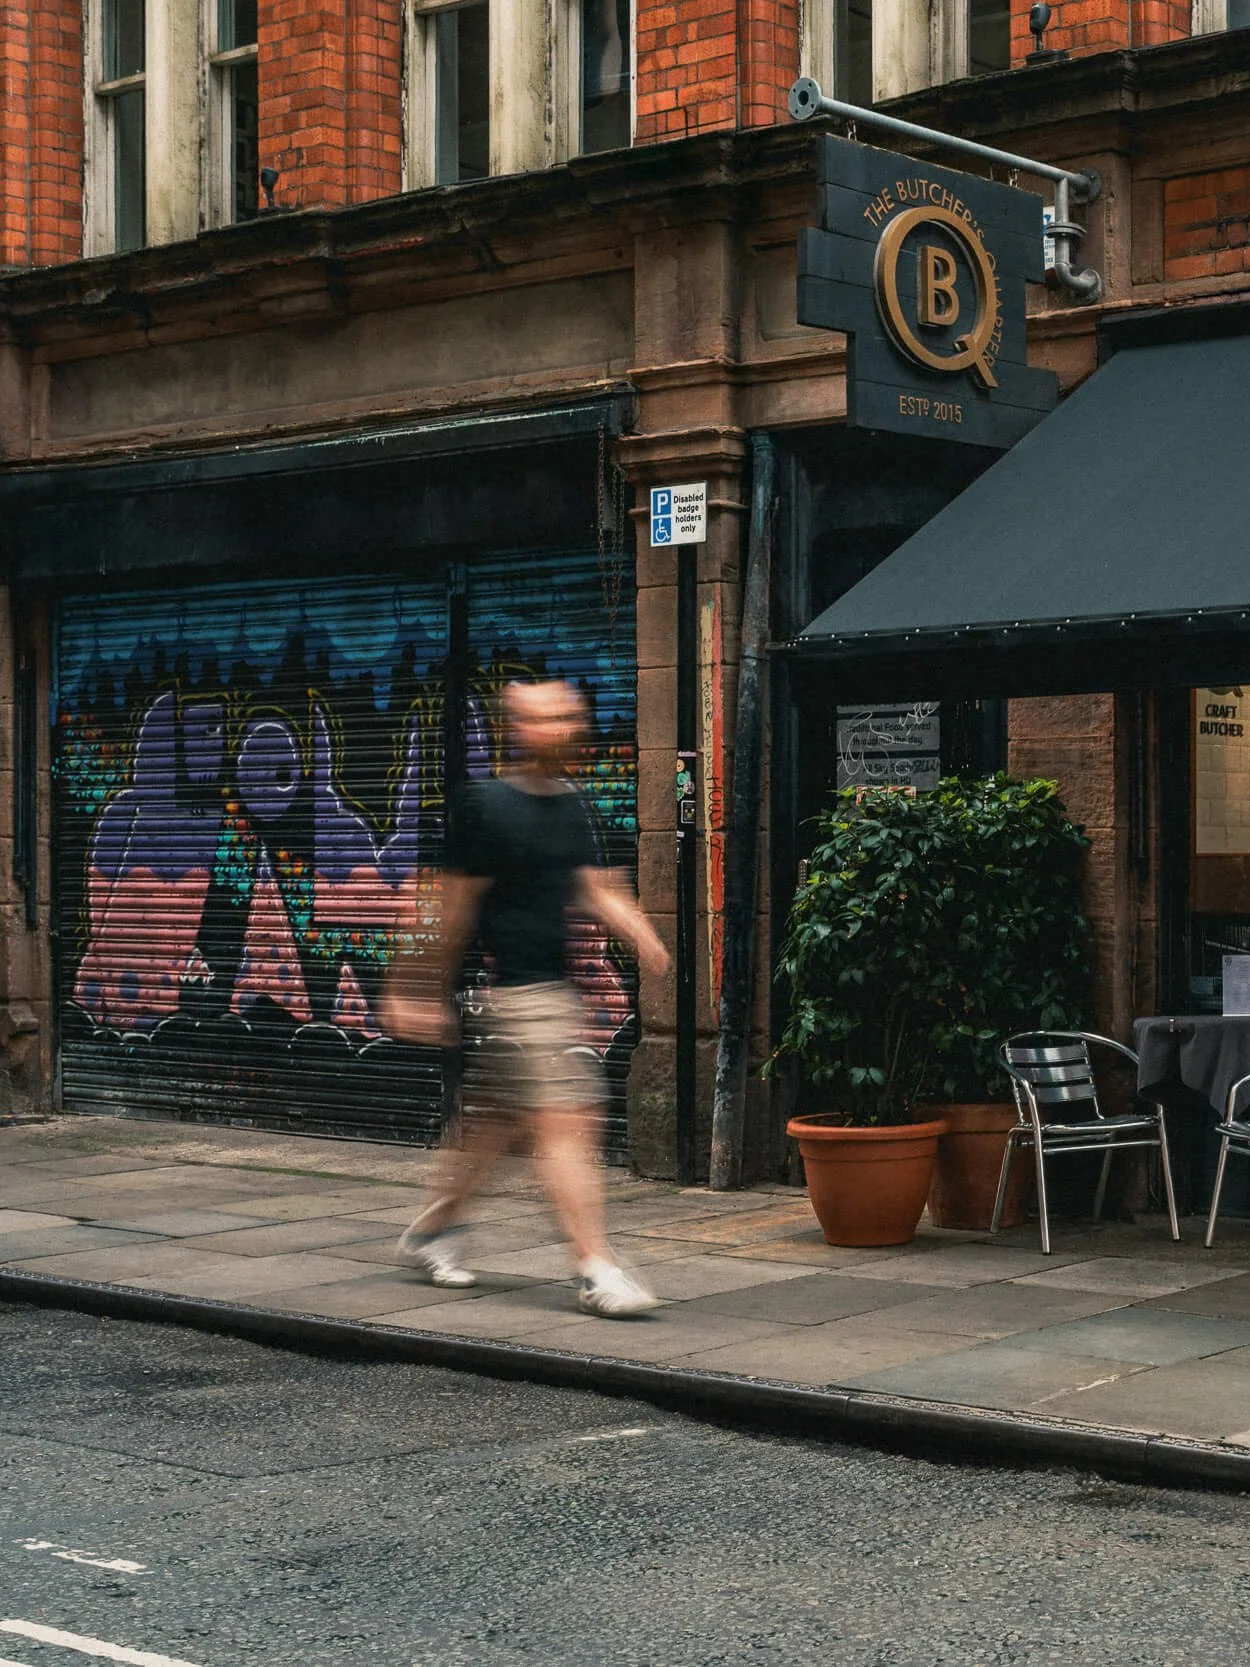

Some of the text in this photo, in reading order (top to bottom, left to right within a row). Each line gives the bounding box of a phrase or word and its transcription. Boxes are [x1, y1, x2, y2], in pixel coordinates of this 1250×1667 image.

[864, 187, 897, 228] THE
[933, 402, 962, 423] 2015
[673, 492, 704, 504] Disabled
[677, 504, 699, 513] badge
[675, 514, 701, 523] holders
[680, 523, 696, 533] only
[1205, 704, 1237, 718] CRAFT
[1200, 721, 1244, 737] BUTCHER
